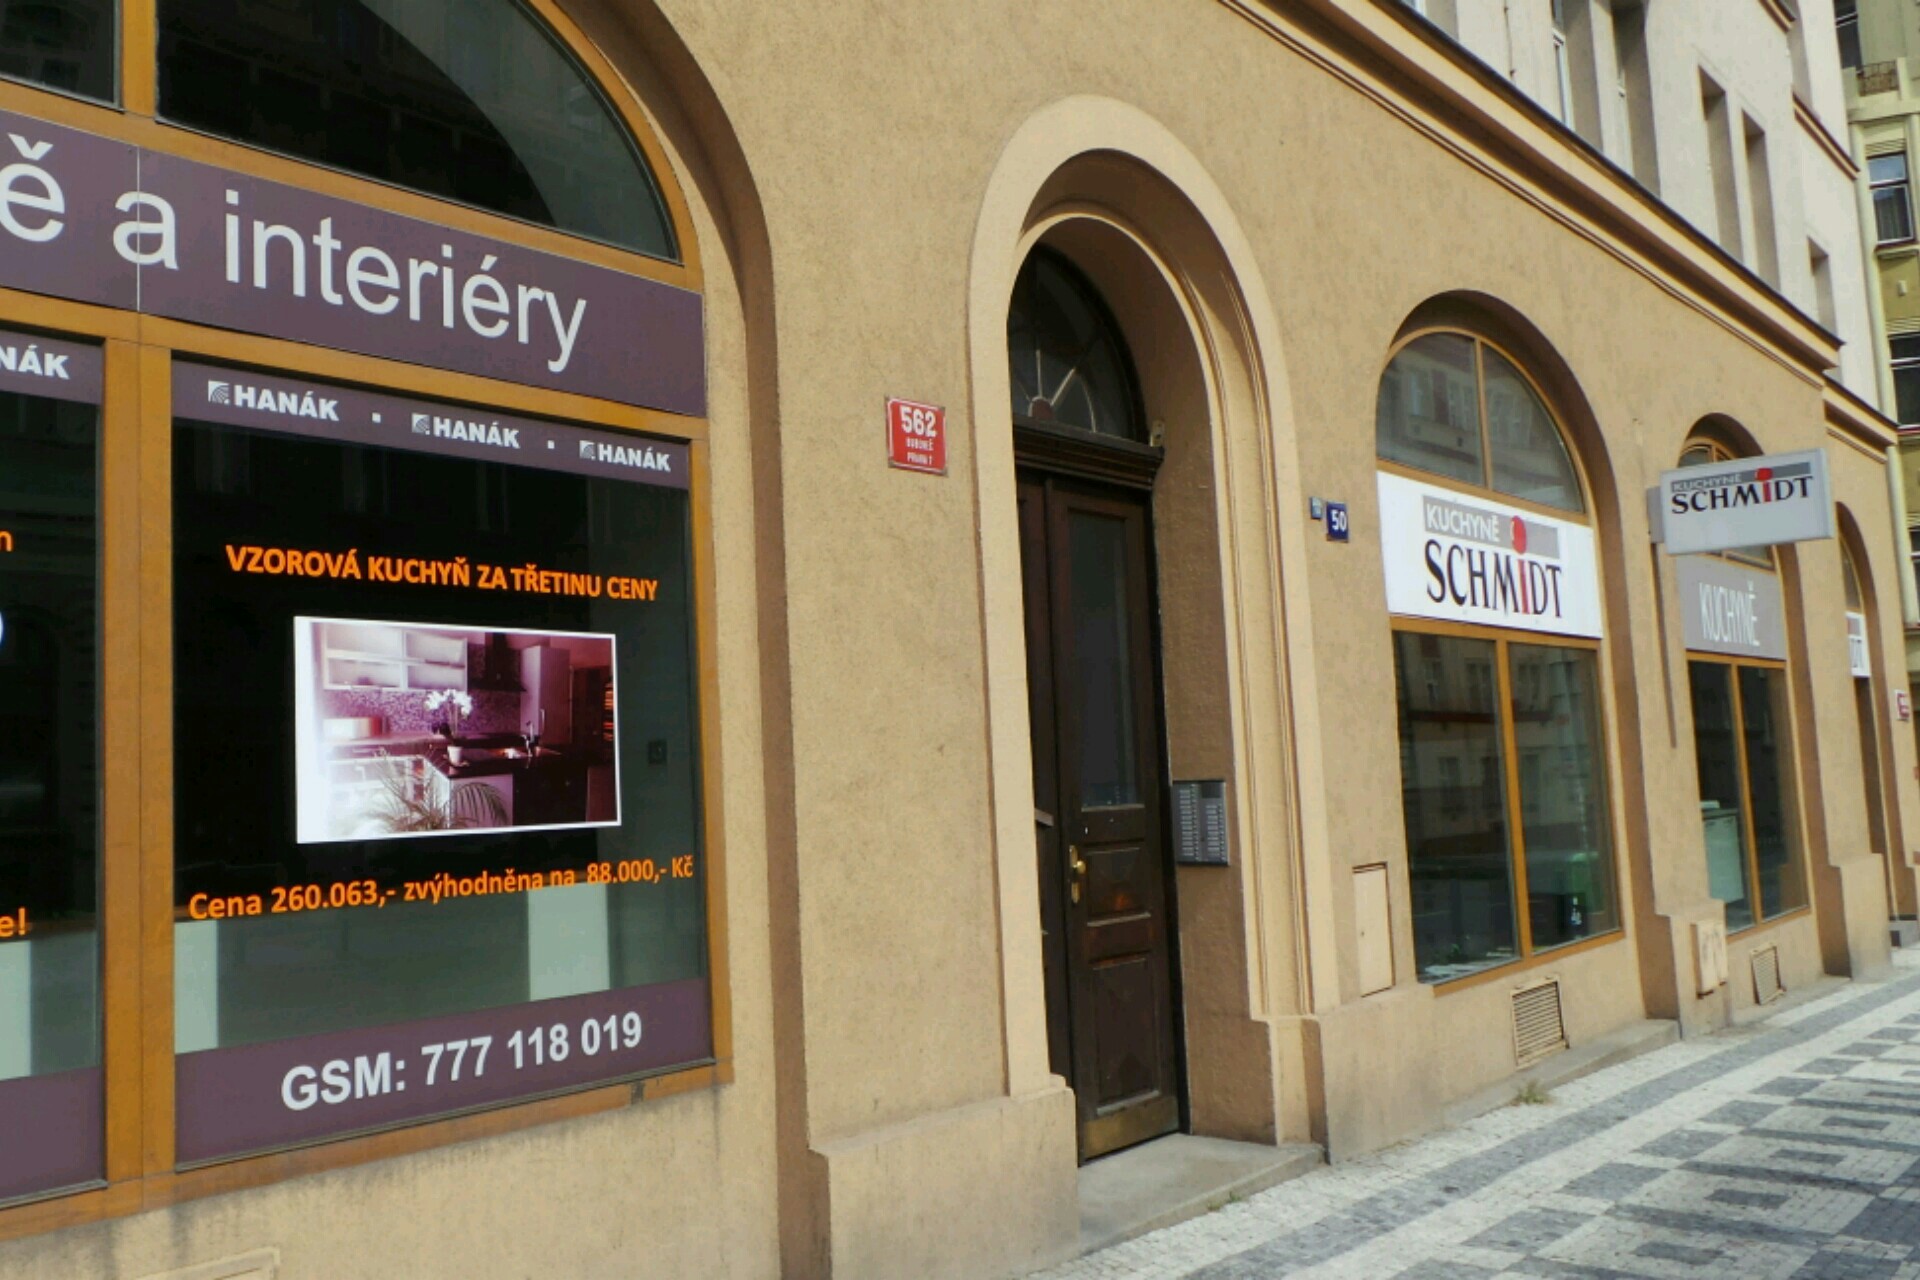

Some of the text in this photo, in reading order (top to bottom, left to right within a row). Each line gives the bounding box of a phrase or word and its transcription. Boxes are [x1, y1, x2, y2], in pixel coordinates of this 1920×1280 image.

[113, 190, 179, 270] a
[225, 188, 587, 373] interiéry
[234, 384, 671, 473] HANÁK HANÁK HANÁK
[900, 405, 938, 438] 562
[1330, 509, 1348, 533] 50
[1426, 503, 1500, 542] KUCHYNĚ
[225, 544, 658, 601] VZOROVÁ KUCHYŇ ZA TŘETINU CENY
[189, 855, 694, 920] Cena 260.063,- zvýhodněna na 88.000,- Kč
[281, 1011, 643, 1111] GSM: 777 118 019
